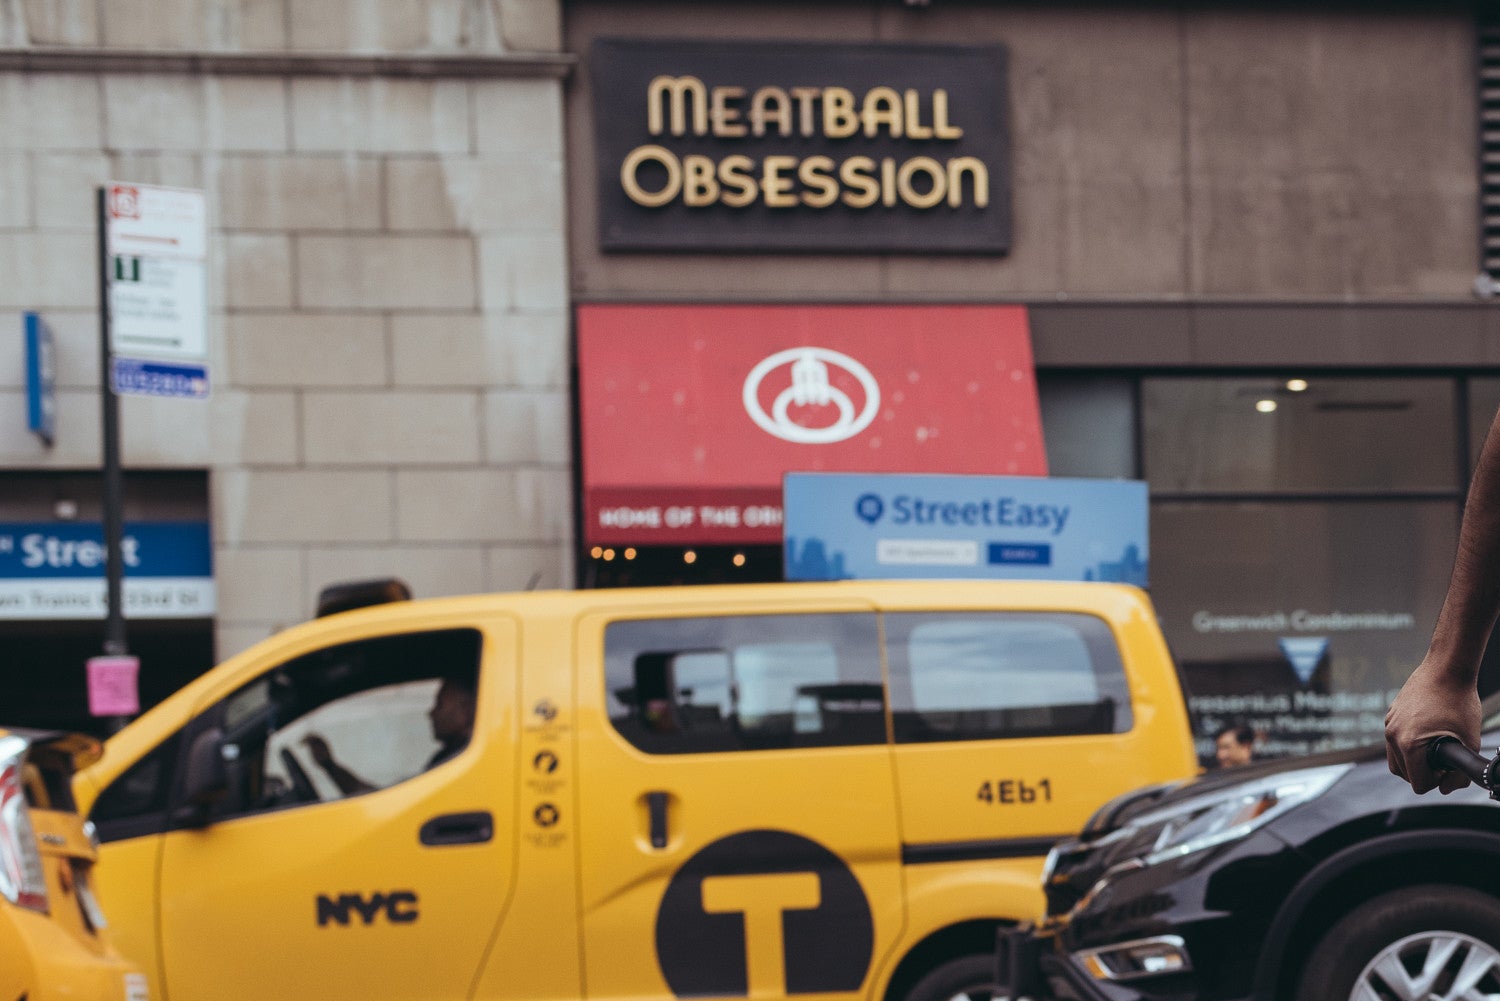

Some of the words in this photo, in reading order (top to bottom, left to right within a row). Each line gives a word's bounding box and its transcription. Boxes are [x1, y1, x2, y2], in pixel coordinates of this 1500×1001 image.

[638, 75, 964, 139] MEATBALL
[620, 144, 989, 208] OBSESSION
[600, 506, 660, 528] HOME
[664, 506, 694, 528] OF
[701, 506, 739, 527] THE
[892, 495, 1071, 535] StreetEasy
[977, 779, 1051, 804] 4Eb1
[317, 891, 418, 926] NYC
